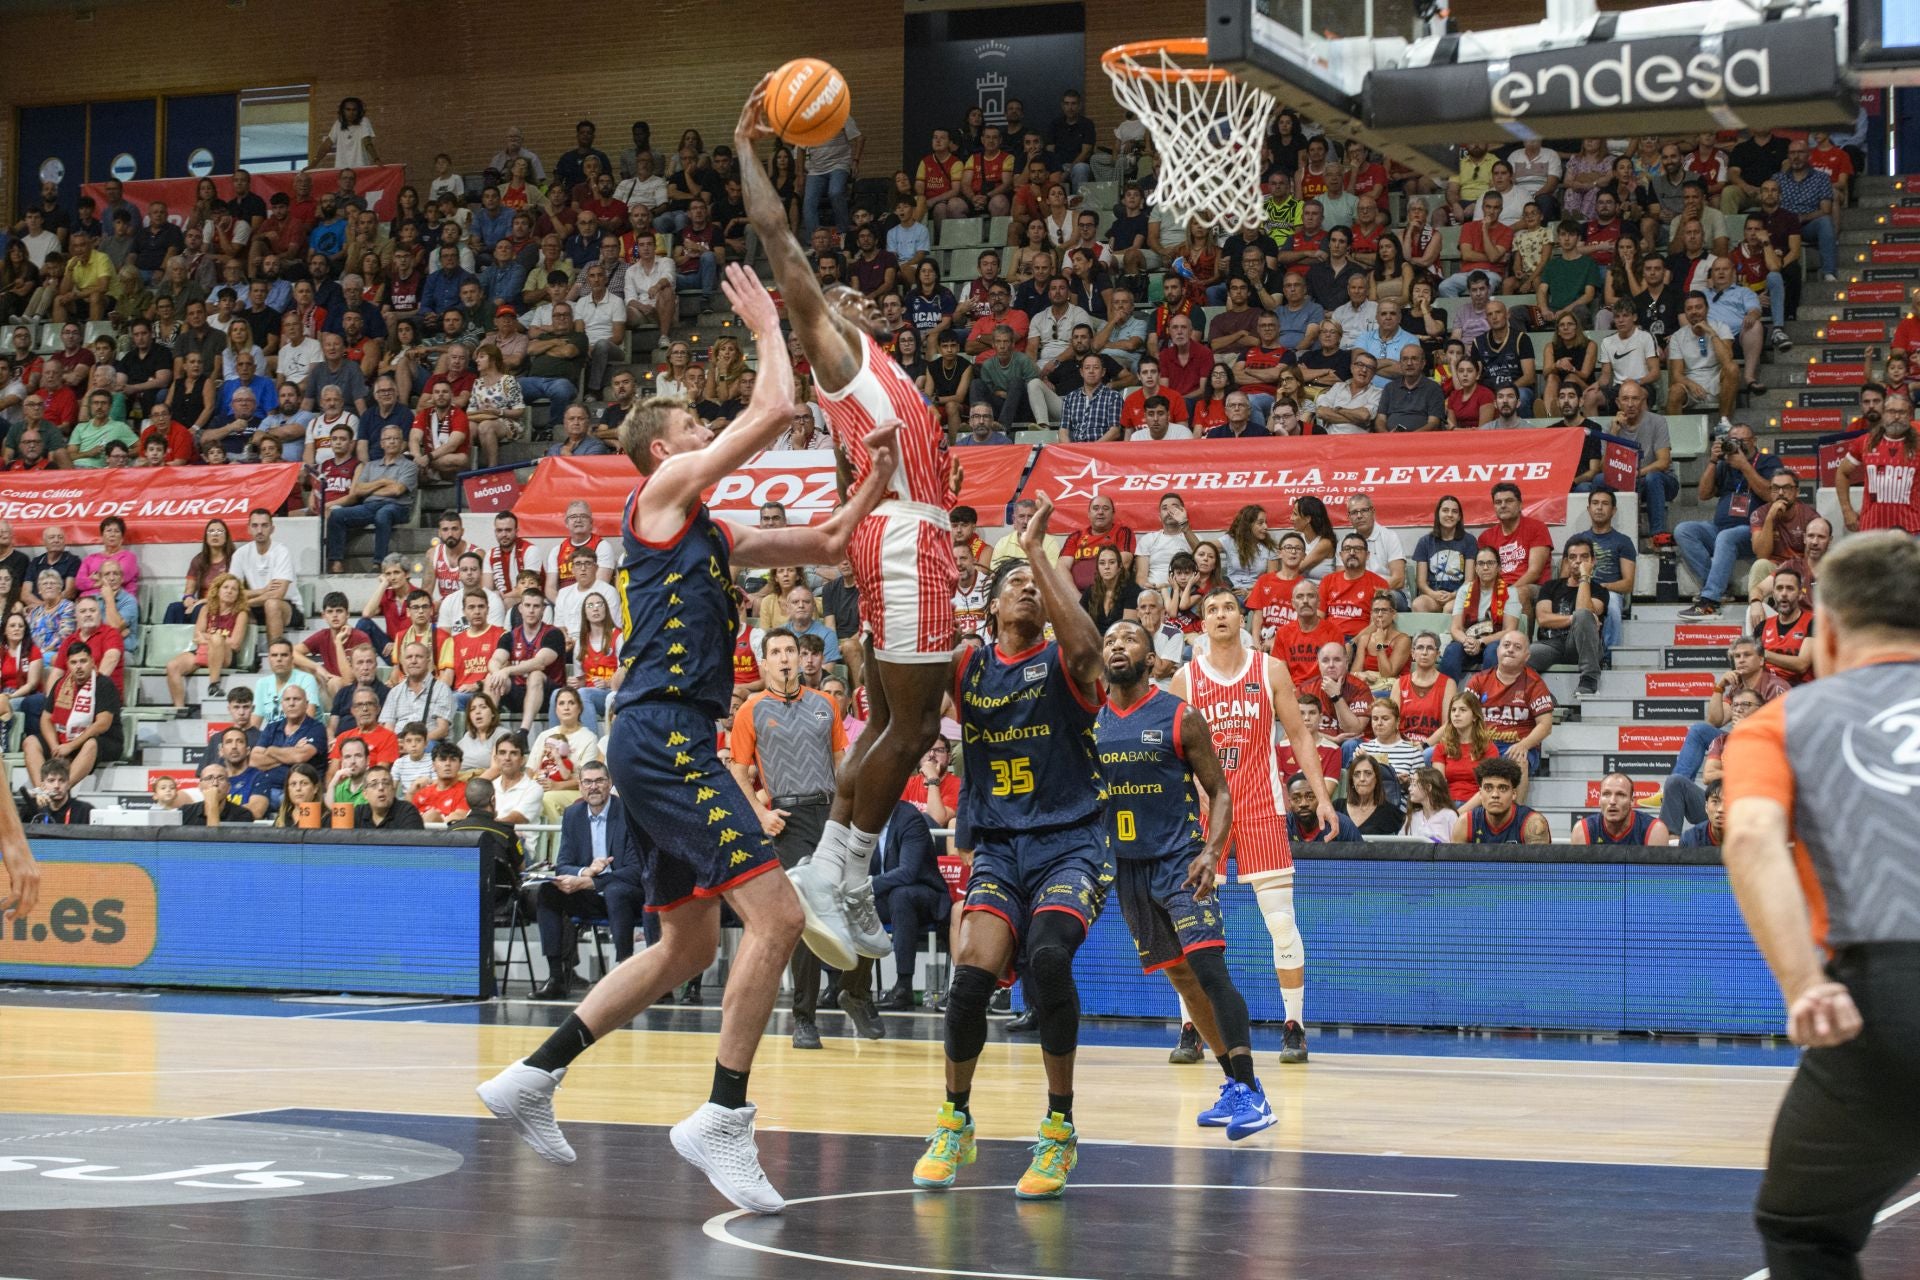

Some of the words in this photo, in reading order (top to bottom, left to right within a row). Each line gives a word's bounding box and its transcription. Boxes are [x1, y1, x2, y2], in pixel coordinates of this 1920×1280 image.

[1491, 44, 1770, 117] endesa
[801, 75, 843, 120] Wilson
[1119, 469, 1324, 491] ESTRELLA
[1332, 471, 1359, 481] DE
[1360, 462, 1552, 485] LEVANTE
[1, 489, 39, 499] Costa
[42, 488, 84, 499] Cálida
[474, 484, 513, 499] MÓDULO
[705, 472, 838, 508] POZ
[1284, 486, 1340, 495] MURCIA
[94, 500, 134, 518] DE
[137, 498, 251, 517] MURCIA
[1074, 546, 1100, 560] UCA
[1201, 700, 1260, 723] UCAM
[982, 724, 1051, 743] Andorra
[1212, 720, 1252, 733] MURCIA
[1099, 751, 1163, 764] ORABANC
[990, 756, 1035, 797] 35
[1117, 810, 1137, 841] 0
